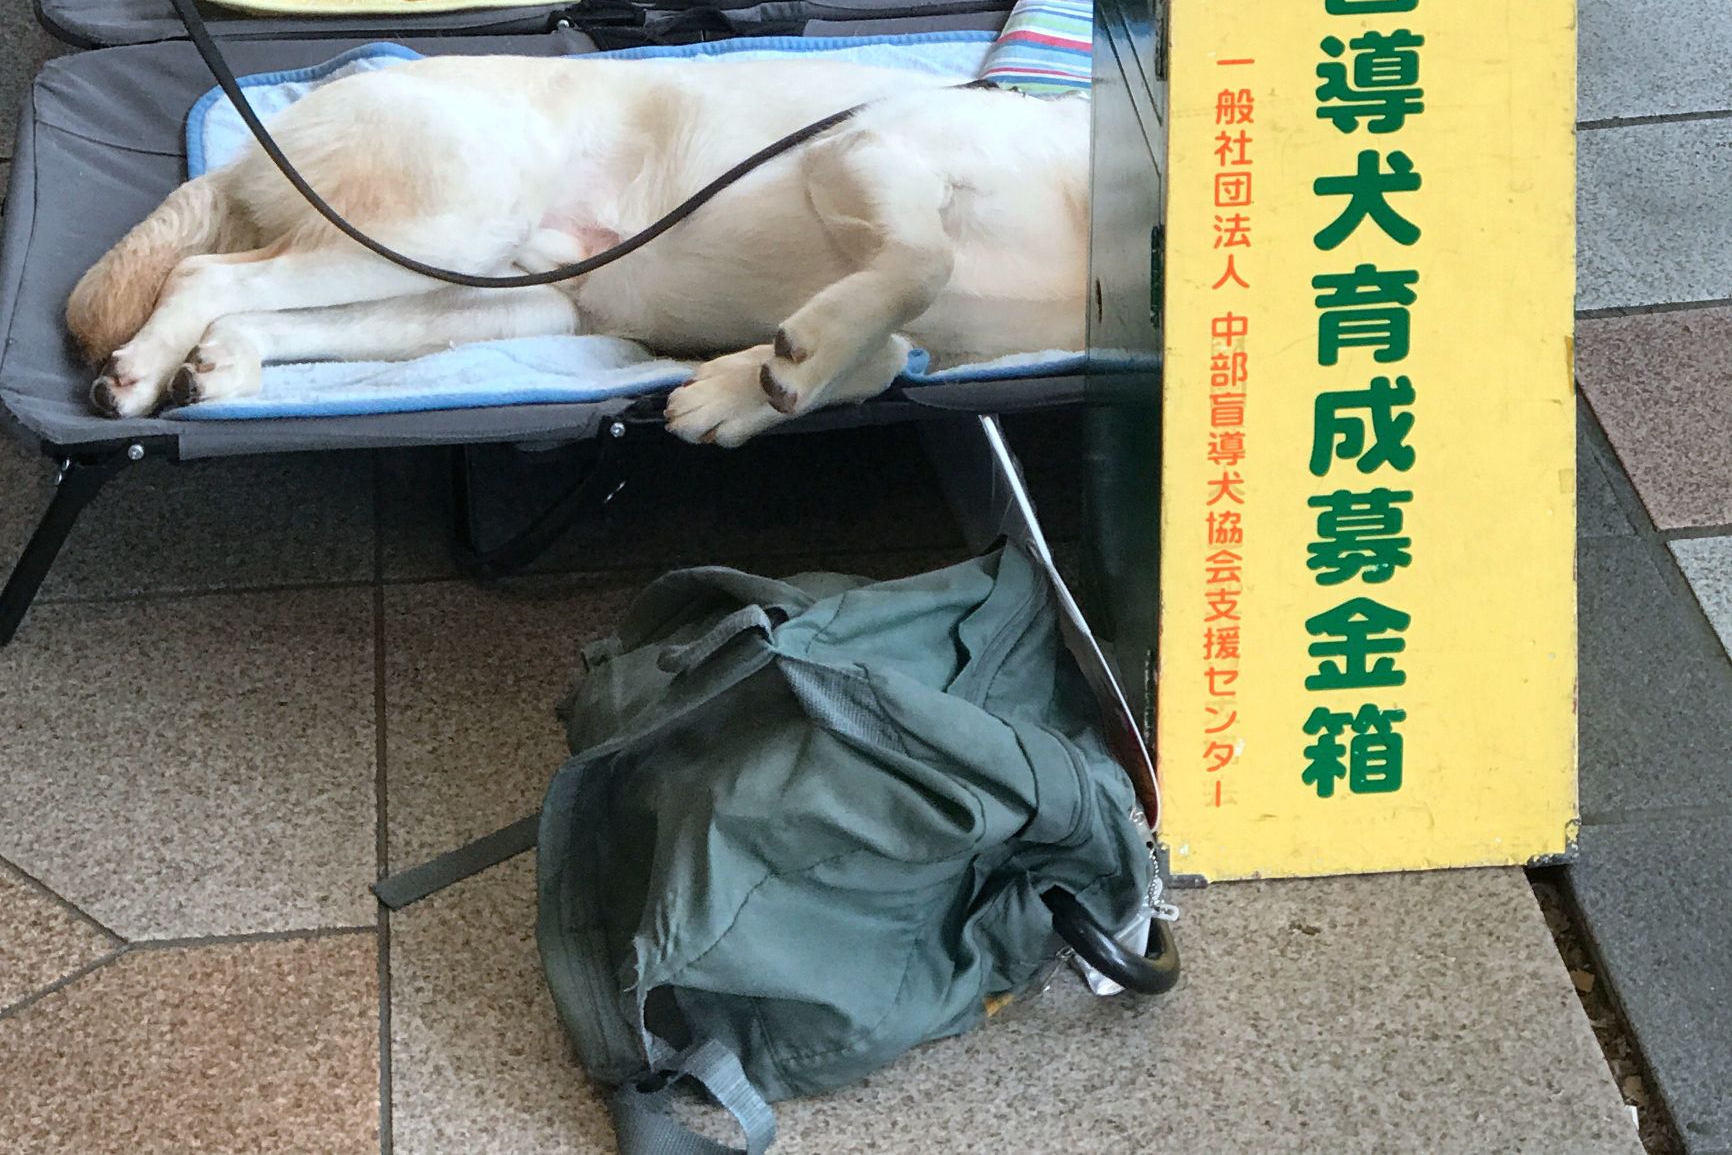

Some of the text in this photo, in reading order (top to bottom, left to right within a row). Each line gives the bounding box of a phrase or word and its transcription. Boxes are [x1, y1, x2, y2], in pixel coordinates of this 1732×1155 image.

[1203, 58, 1254, 807] 一般社団法人 中部盲導犬協会支援センター
